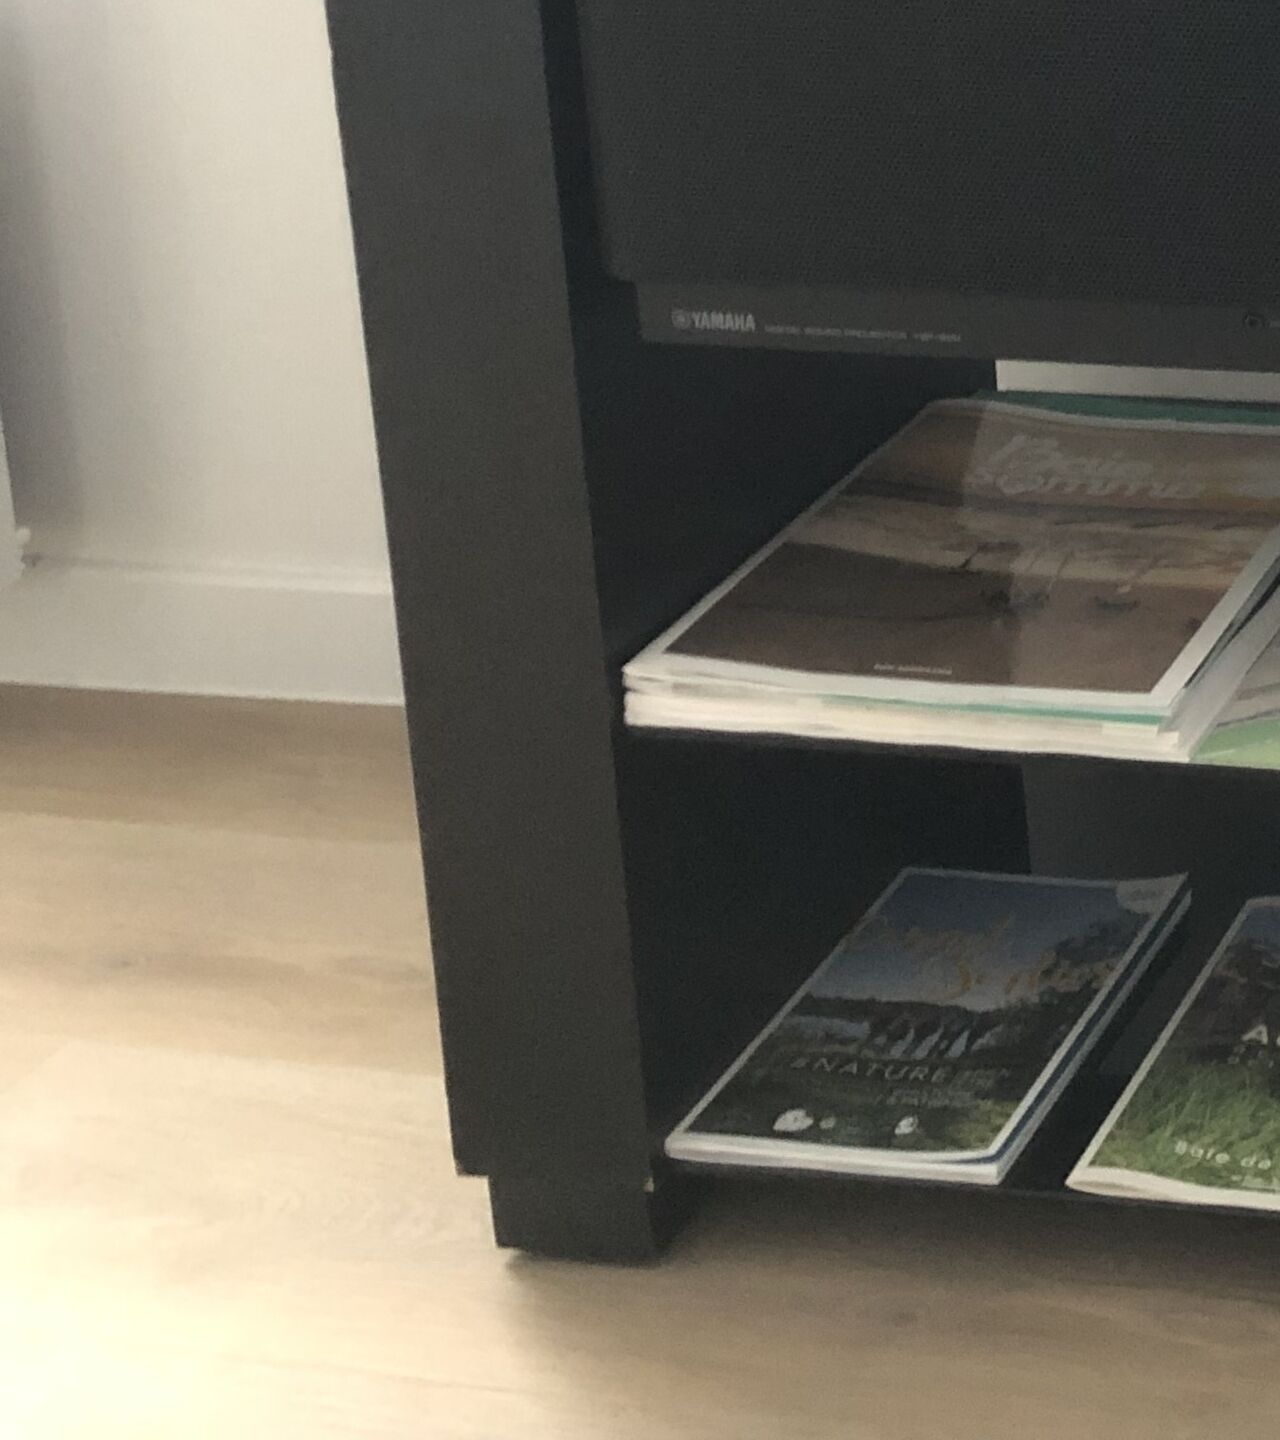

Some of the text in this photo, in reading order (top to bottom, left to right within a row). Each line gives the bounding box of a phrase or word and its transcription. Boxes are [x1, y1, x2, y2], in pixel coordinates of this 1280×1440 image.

[691, 311, 755, 332] YAMAHA
[1174, 1139, 1231, 1165] Baie
[1240, 1153, 1272, 1171] de
